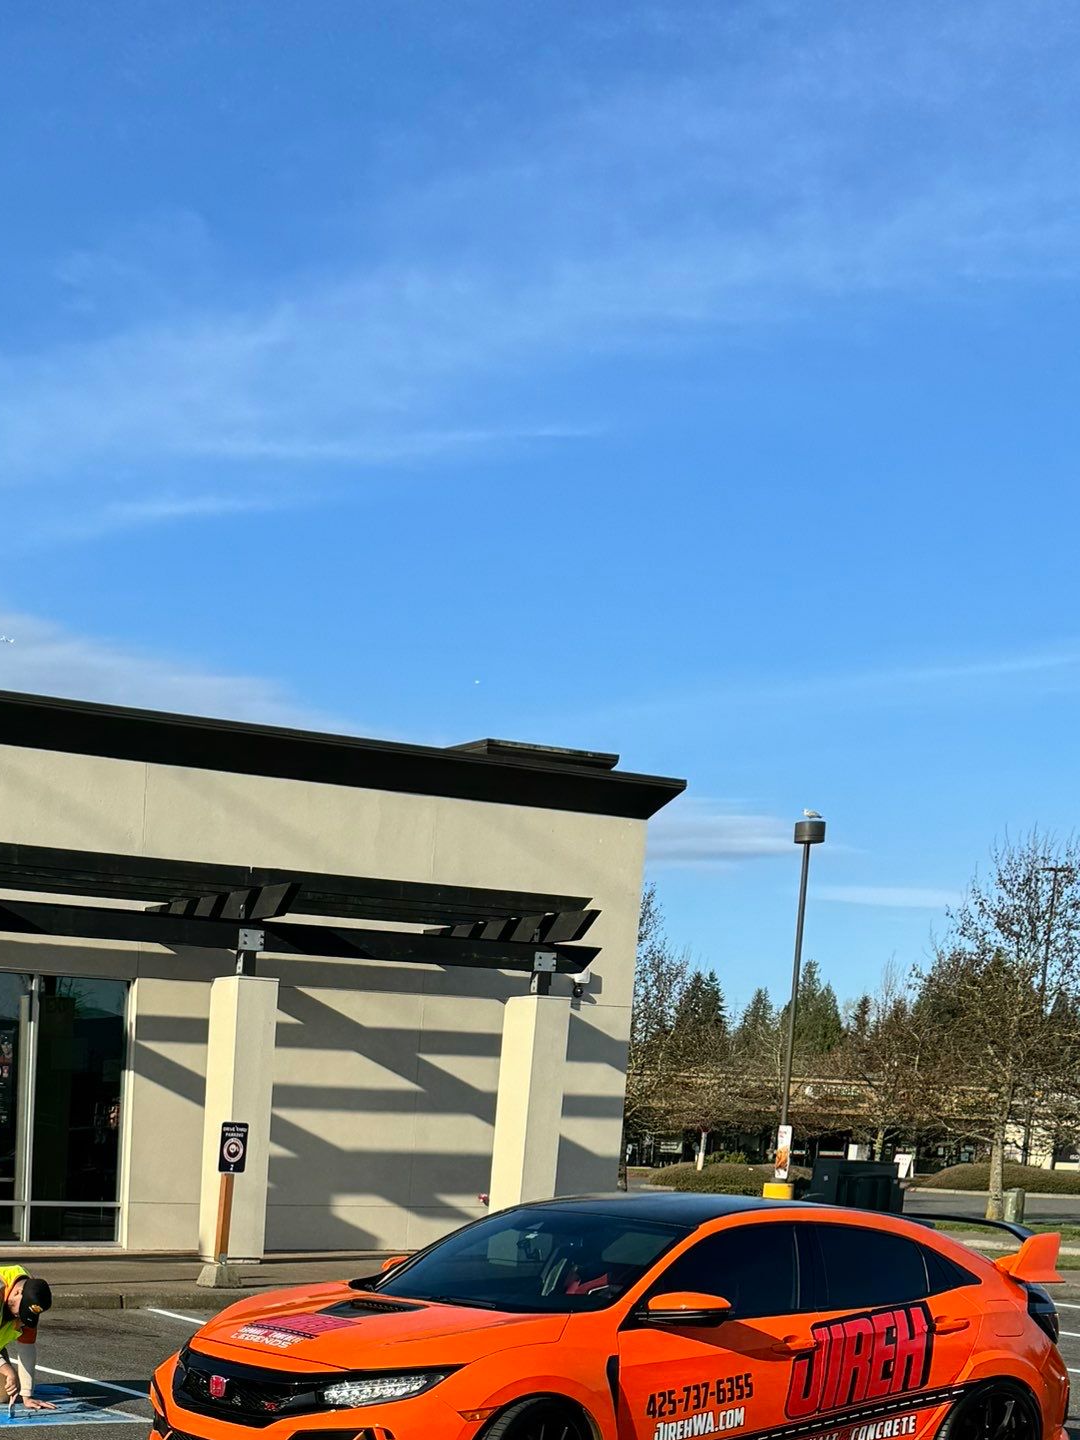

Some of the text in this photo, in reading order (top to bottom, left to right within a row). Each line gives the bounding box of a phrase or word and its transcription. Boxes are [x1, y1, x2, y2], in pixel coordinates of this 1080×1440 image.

[230, 1332, 293, 1349] LEGENDS
[784, 1303, 935, 1420] JIREH
[646, 1373, 753, 1419] 425-737-6355
